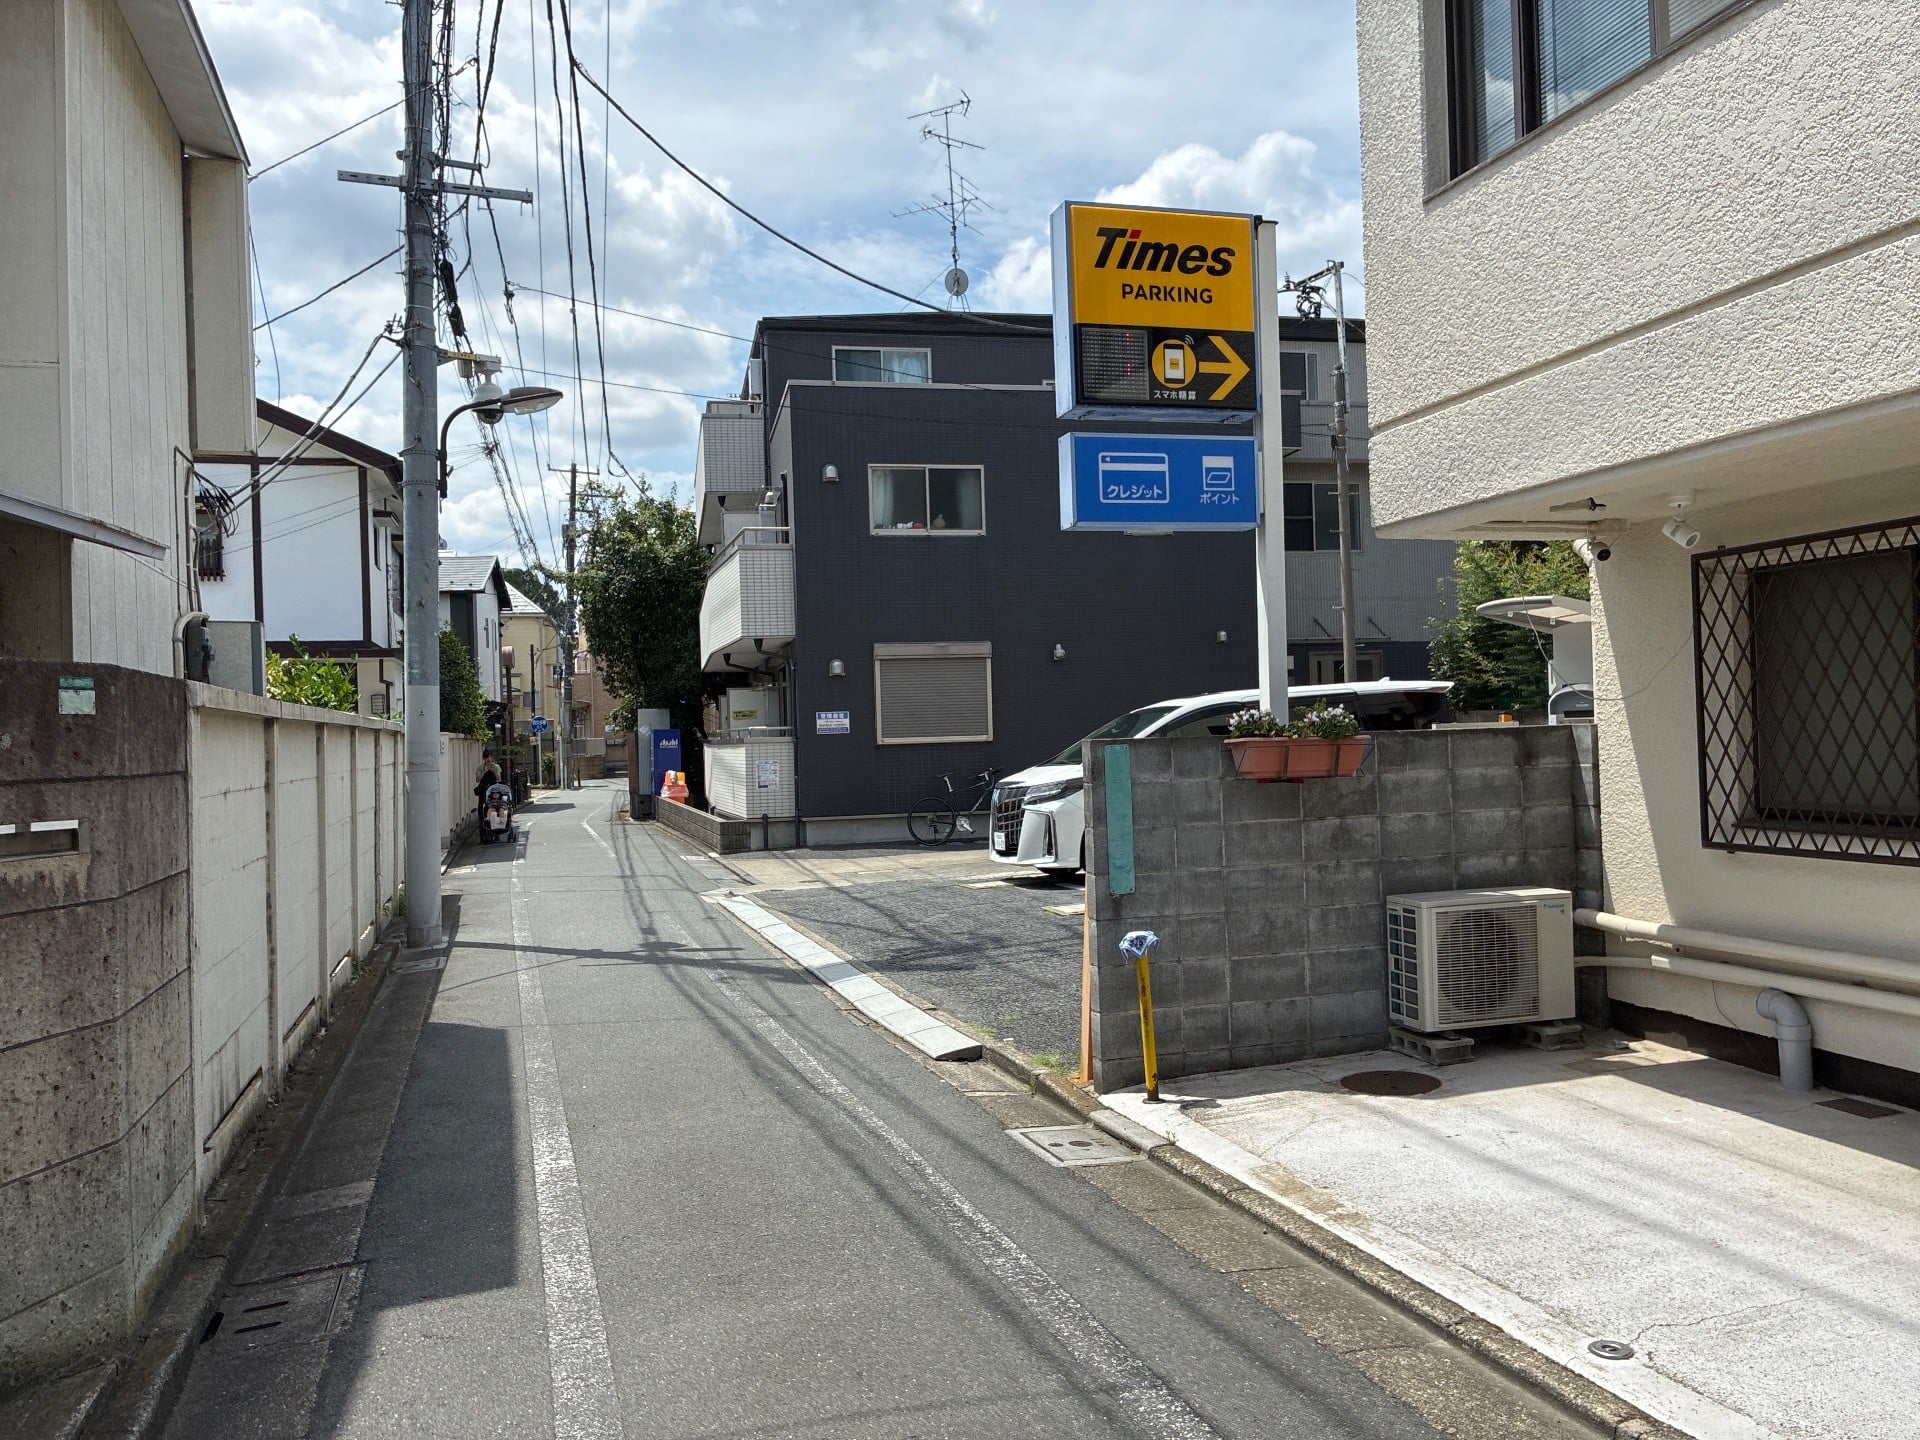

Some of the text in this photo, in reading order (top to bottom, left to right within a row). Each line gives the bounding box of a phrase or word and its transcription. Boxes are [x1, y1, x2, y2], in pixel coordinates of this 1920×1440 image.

[1094, 227, 1236, 277] Times
[1121, 283, 1213, 304] PARKING
[1153, 390, 1197, 401] スマホ精算
[1107, 484, 1163, 499] クレジット
[1200, 493, 1240, 505] ポイント
